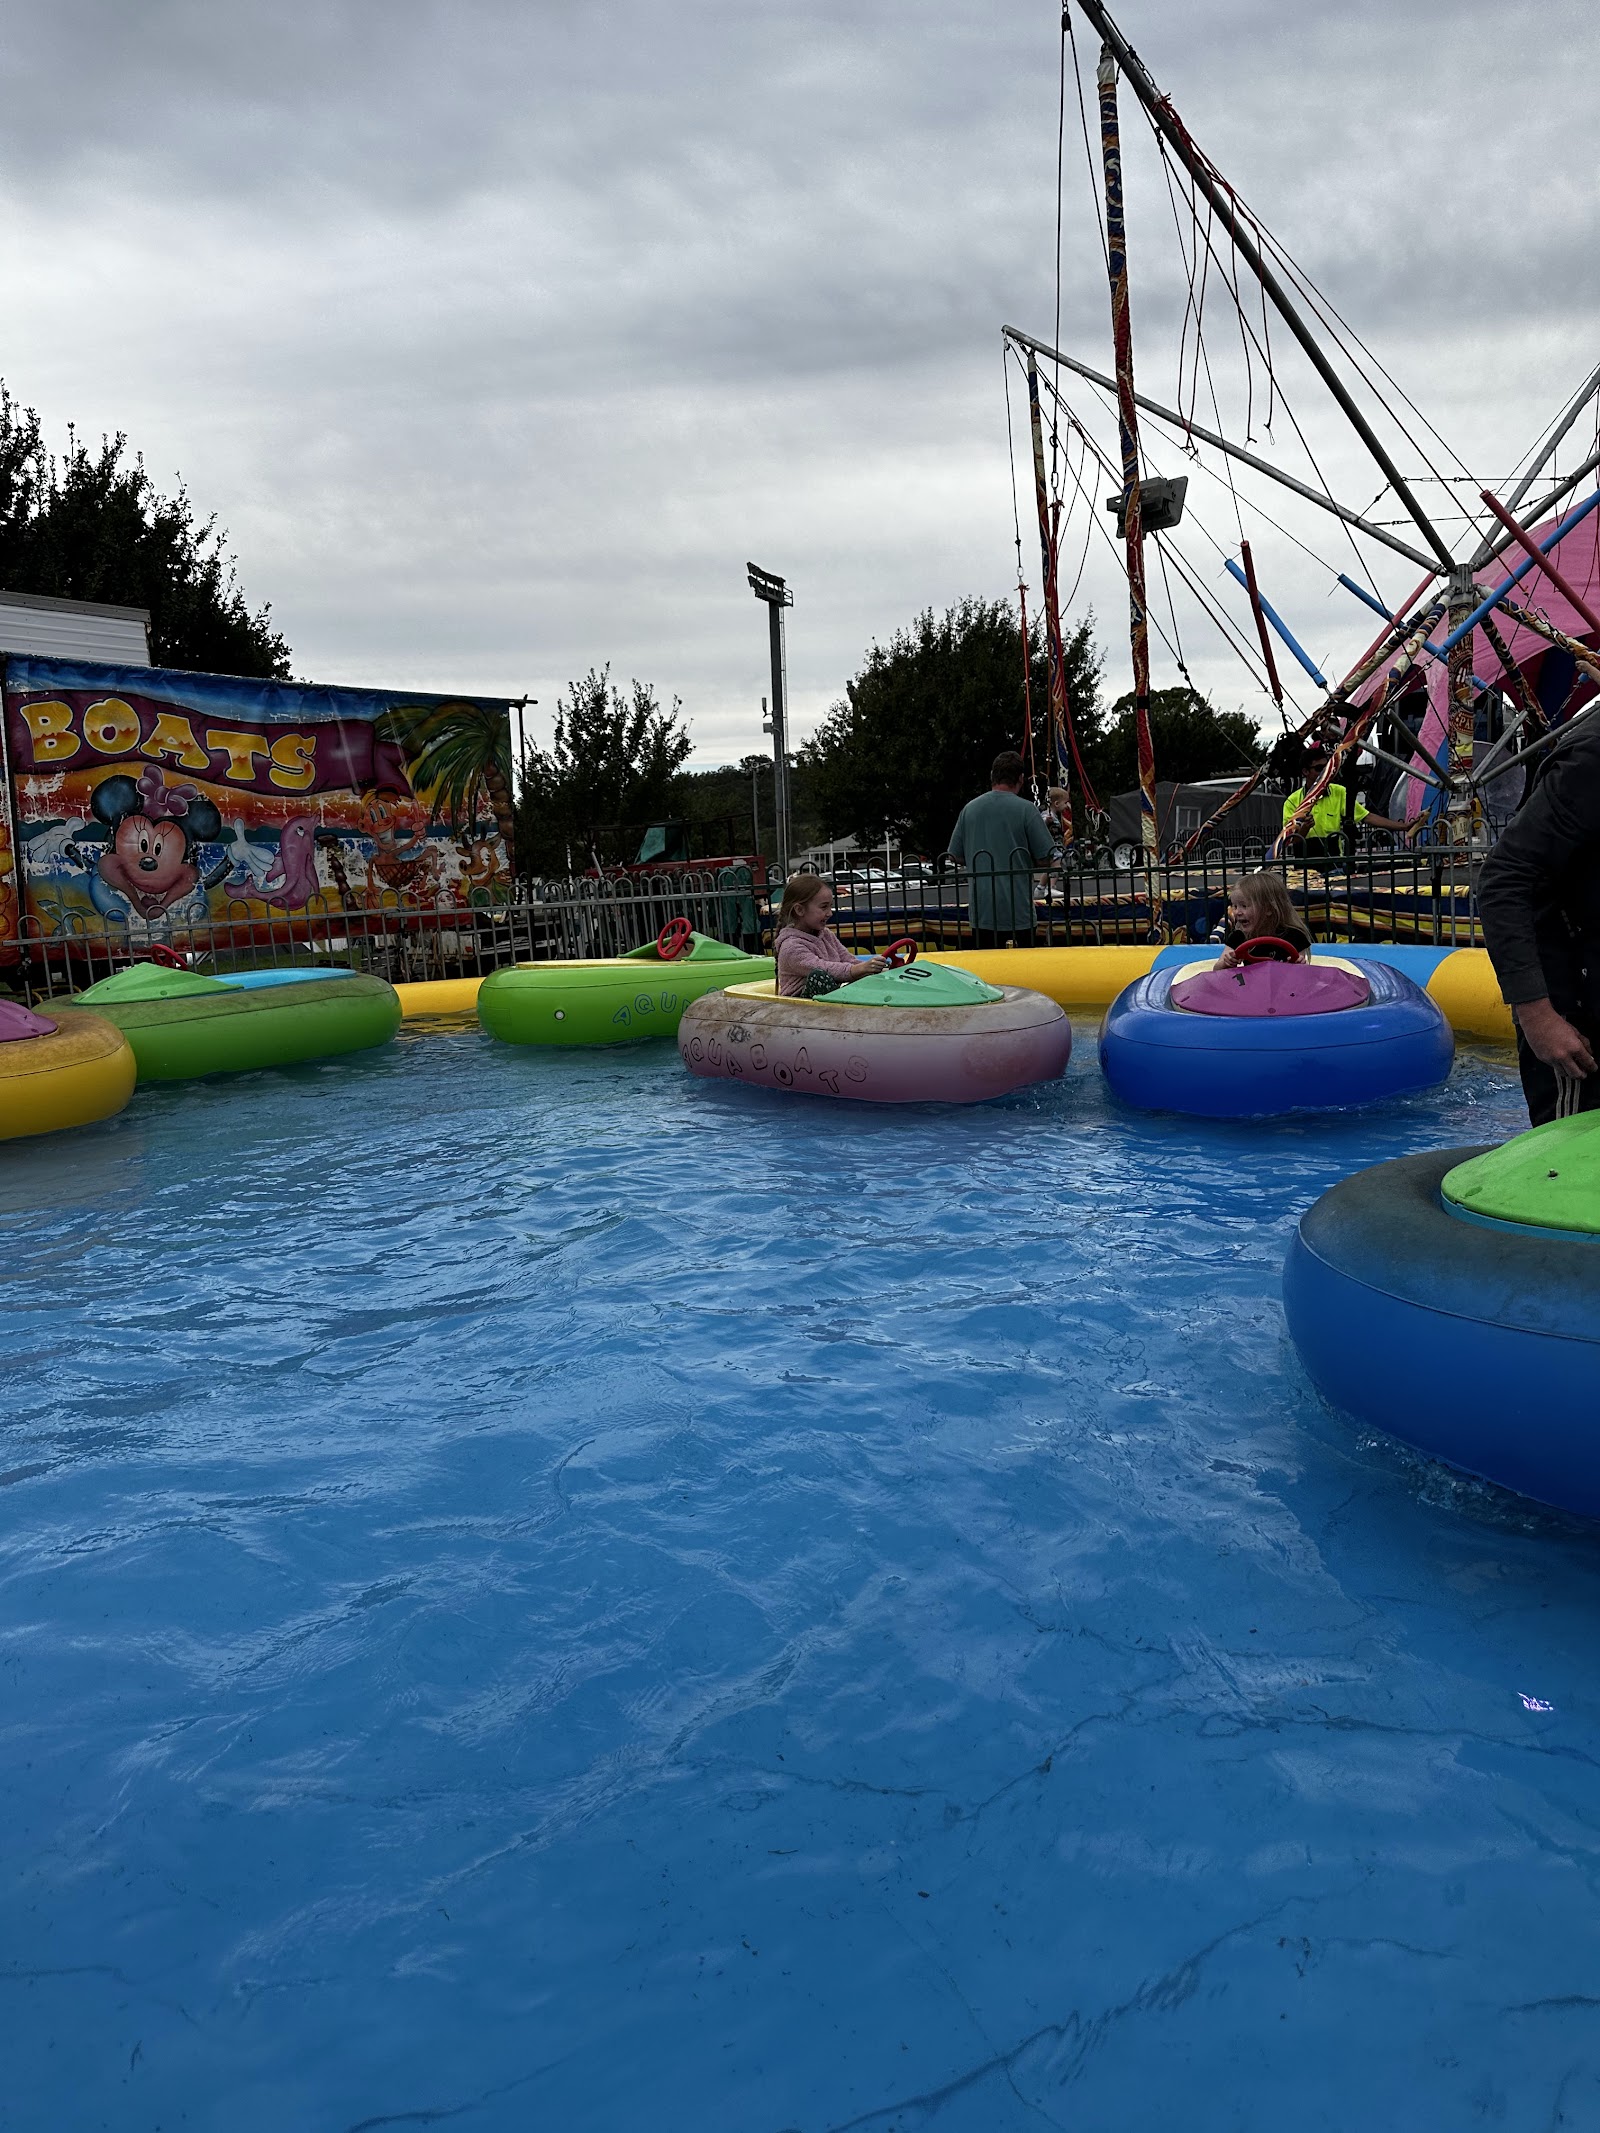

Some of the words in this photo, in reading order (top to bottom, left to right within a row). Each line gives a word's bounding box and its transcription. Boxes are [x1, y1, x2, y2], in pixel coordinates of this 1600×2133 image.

[21, 698, 316, 789] BOATS
[899, 967, 932, 981] 10
[683, 1036, 743, 1076] AQUA
[750, 1043, 868, 1093] BOATS
